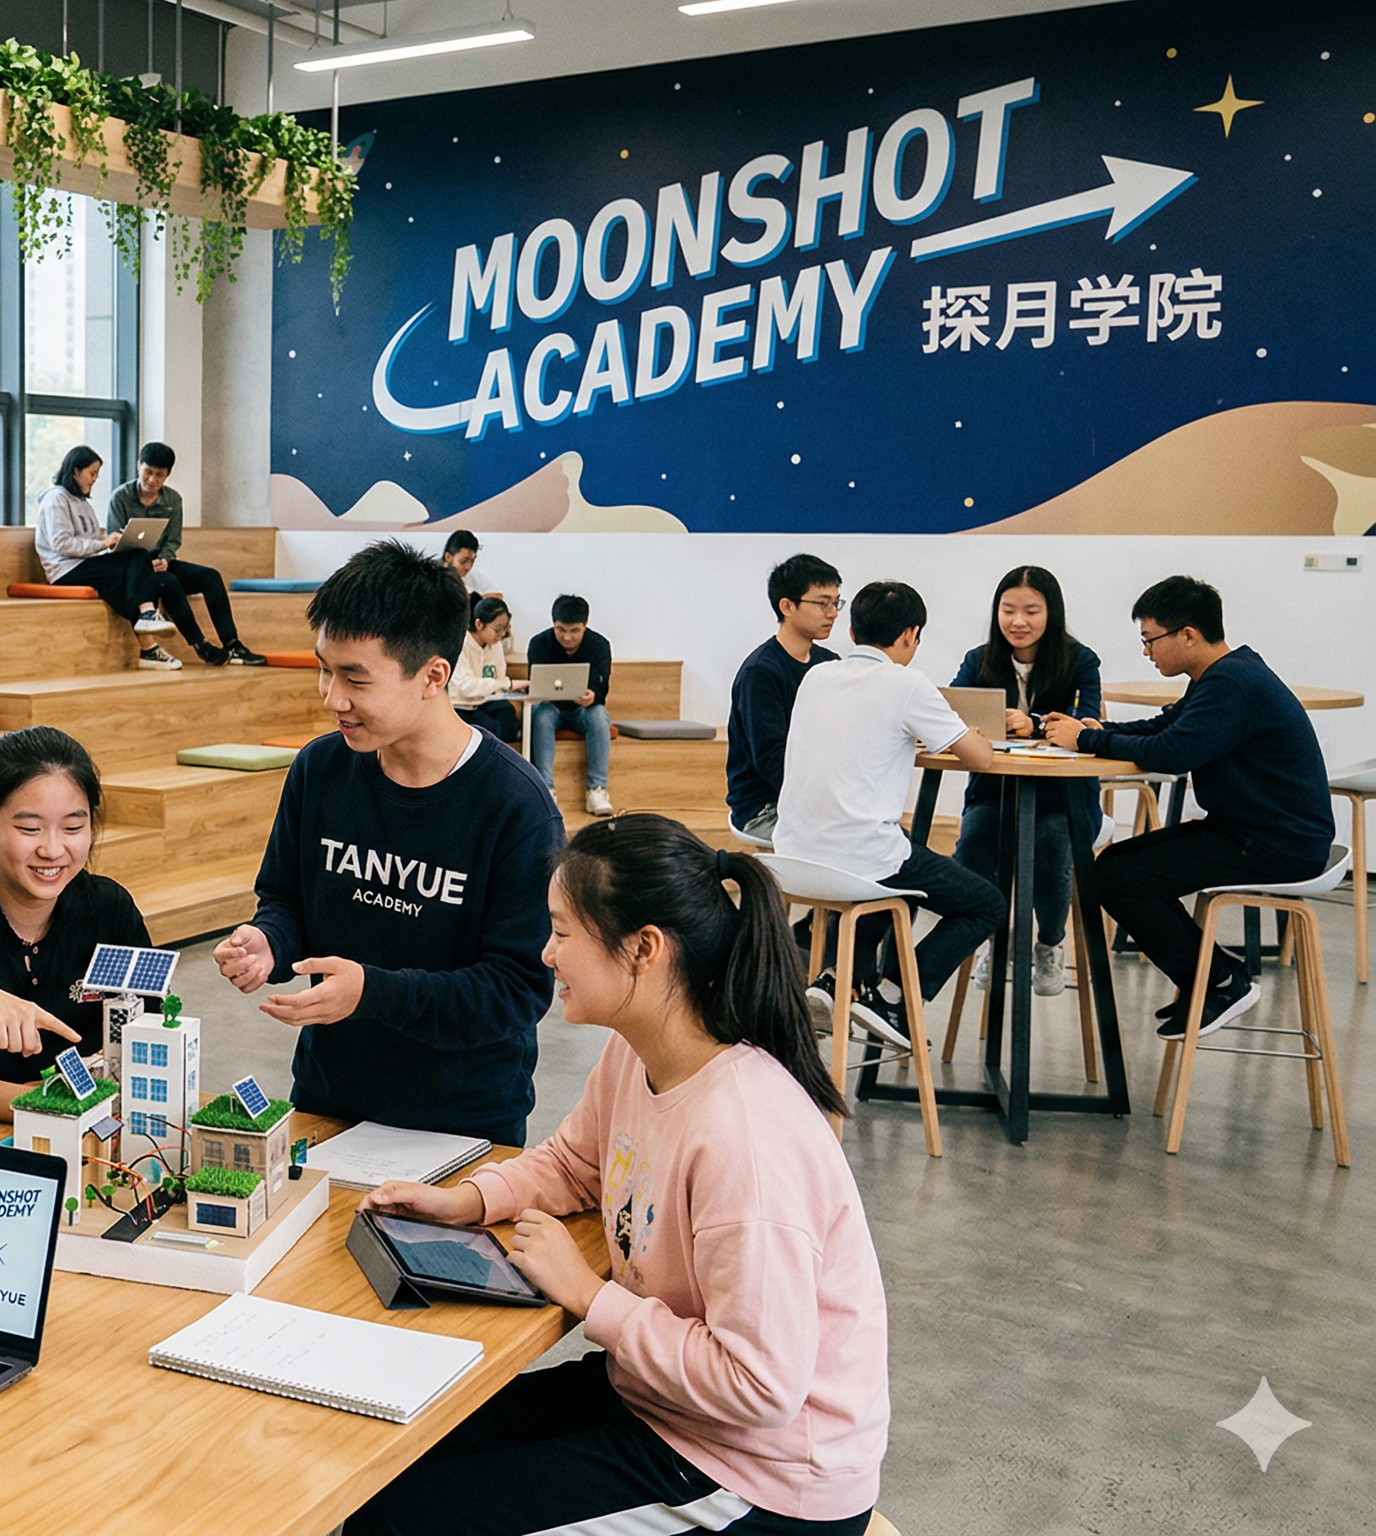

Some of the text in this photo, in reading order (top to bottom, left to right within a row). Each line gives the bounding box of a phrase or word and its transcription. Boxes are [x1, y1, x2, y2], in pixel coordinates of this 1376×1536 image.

[448, 77, 1037, 344] MOONSHOT
[465, 246, 895, 440] ACADEMY
[922, 267, 1223, 354] 探月学院
[320, 837, 468, 905] TANYUE
[352, 888, 423, 918] ACADEMY
